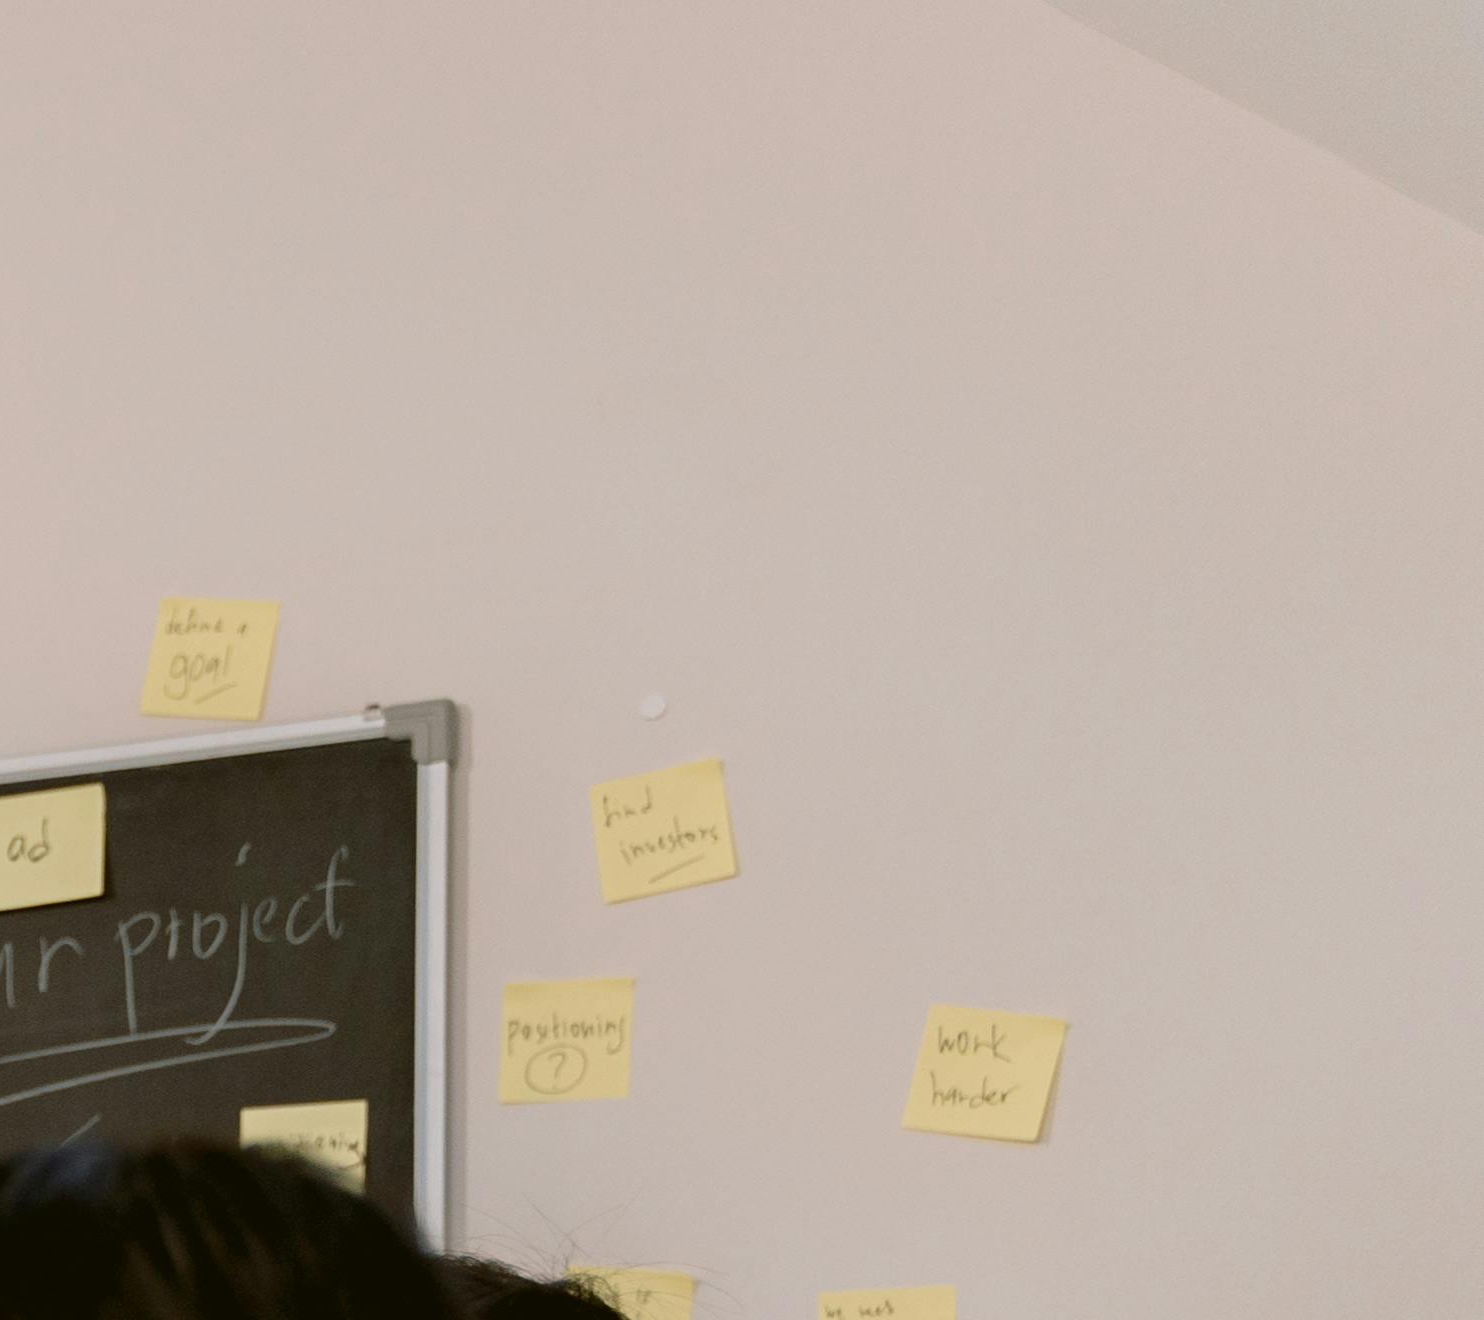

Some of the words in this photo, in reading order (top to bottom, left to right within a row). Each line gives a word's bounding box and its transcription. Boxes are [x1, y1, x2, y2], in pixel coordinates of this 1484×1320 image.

[163, 643, 234, 701] goal
[7, 818, 52, 864] ad
[114, 842, 356, 1047] project
[507, 1013, 626, 1055] positioning
[936, 1024, 1012, 1063] work
[929, 1071, 1021, 1108] harder
